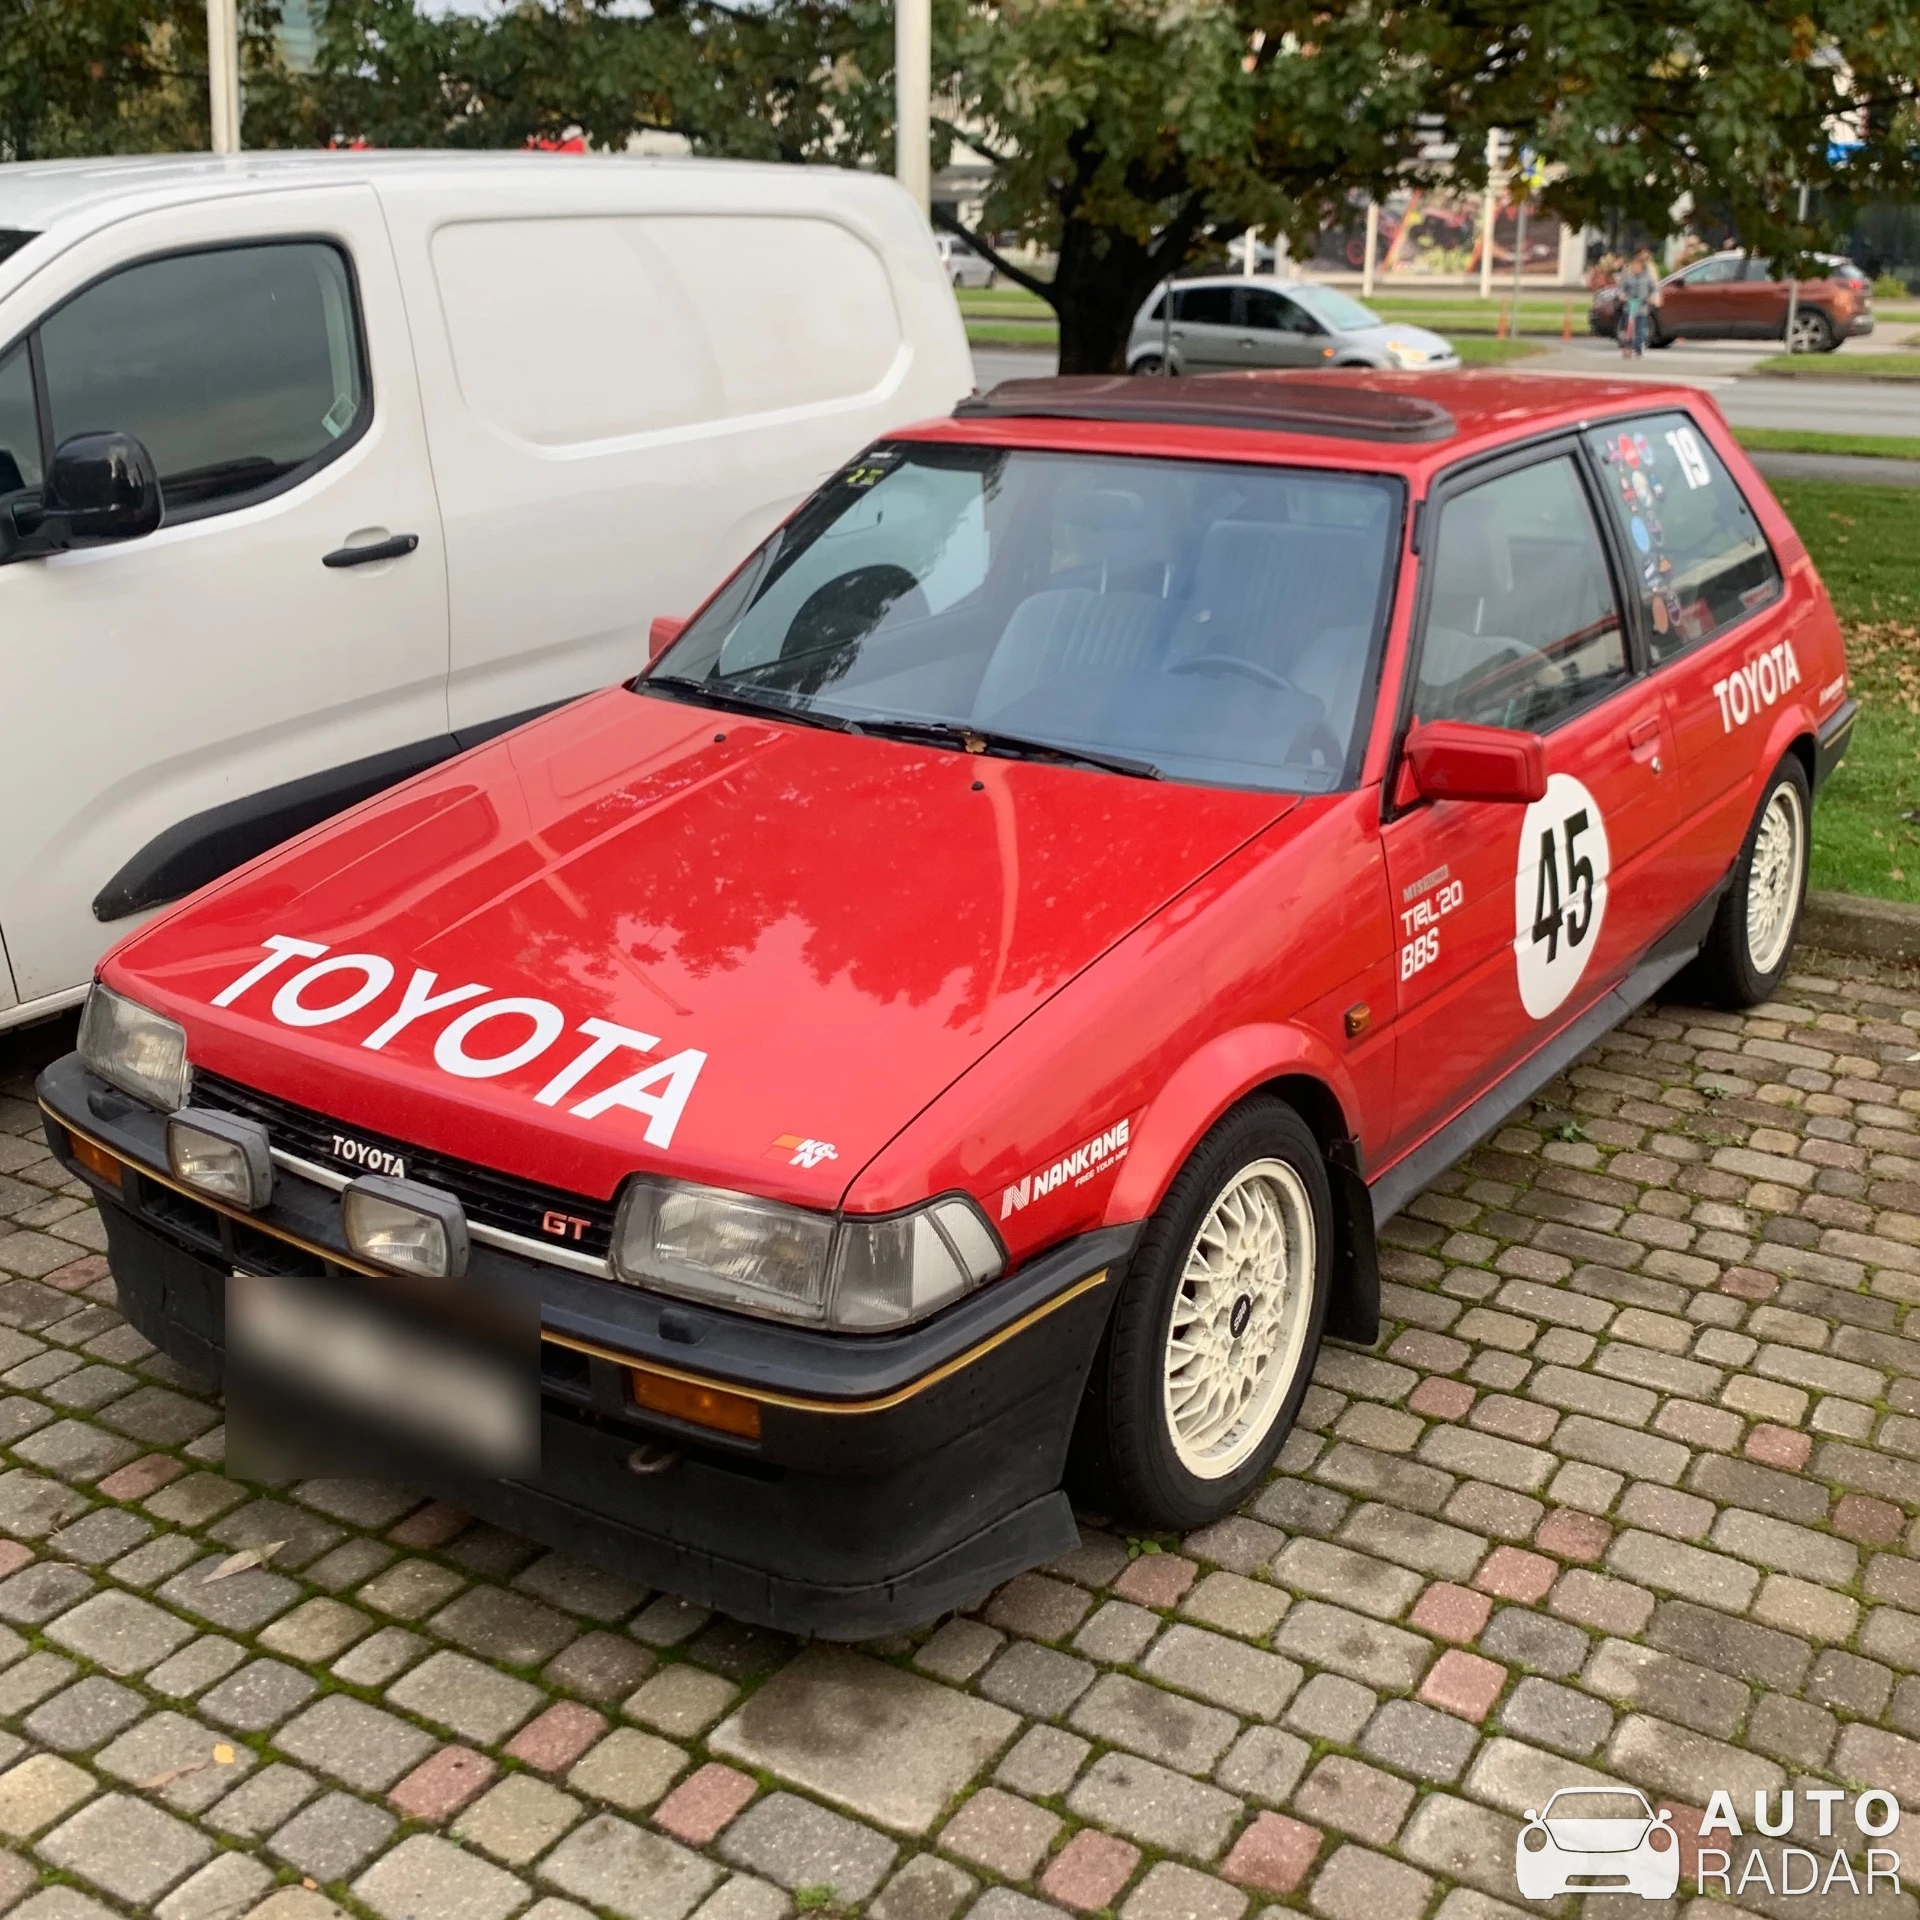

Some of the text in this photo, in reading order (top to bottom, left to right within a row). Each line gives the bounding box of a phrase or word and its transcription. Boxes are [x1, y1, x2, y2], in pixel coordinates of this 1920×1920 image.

[1665, 427, 1711, 489] 19
[1713, 639, 1801, 734] TOYOTA
[1531, 807, 1594, 965] 45
[1401, 926, 1440, 982] BBS
[210, 934, 708, 1150] TOYOTA
[332, 1135, 405, 1179] TOYOTA
[1033, 1118, 1129, 1202] NANKANG
[543, 1210, 592, 1240] GT
